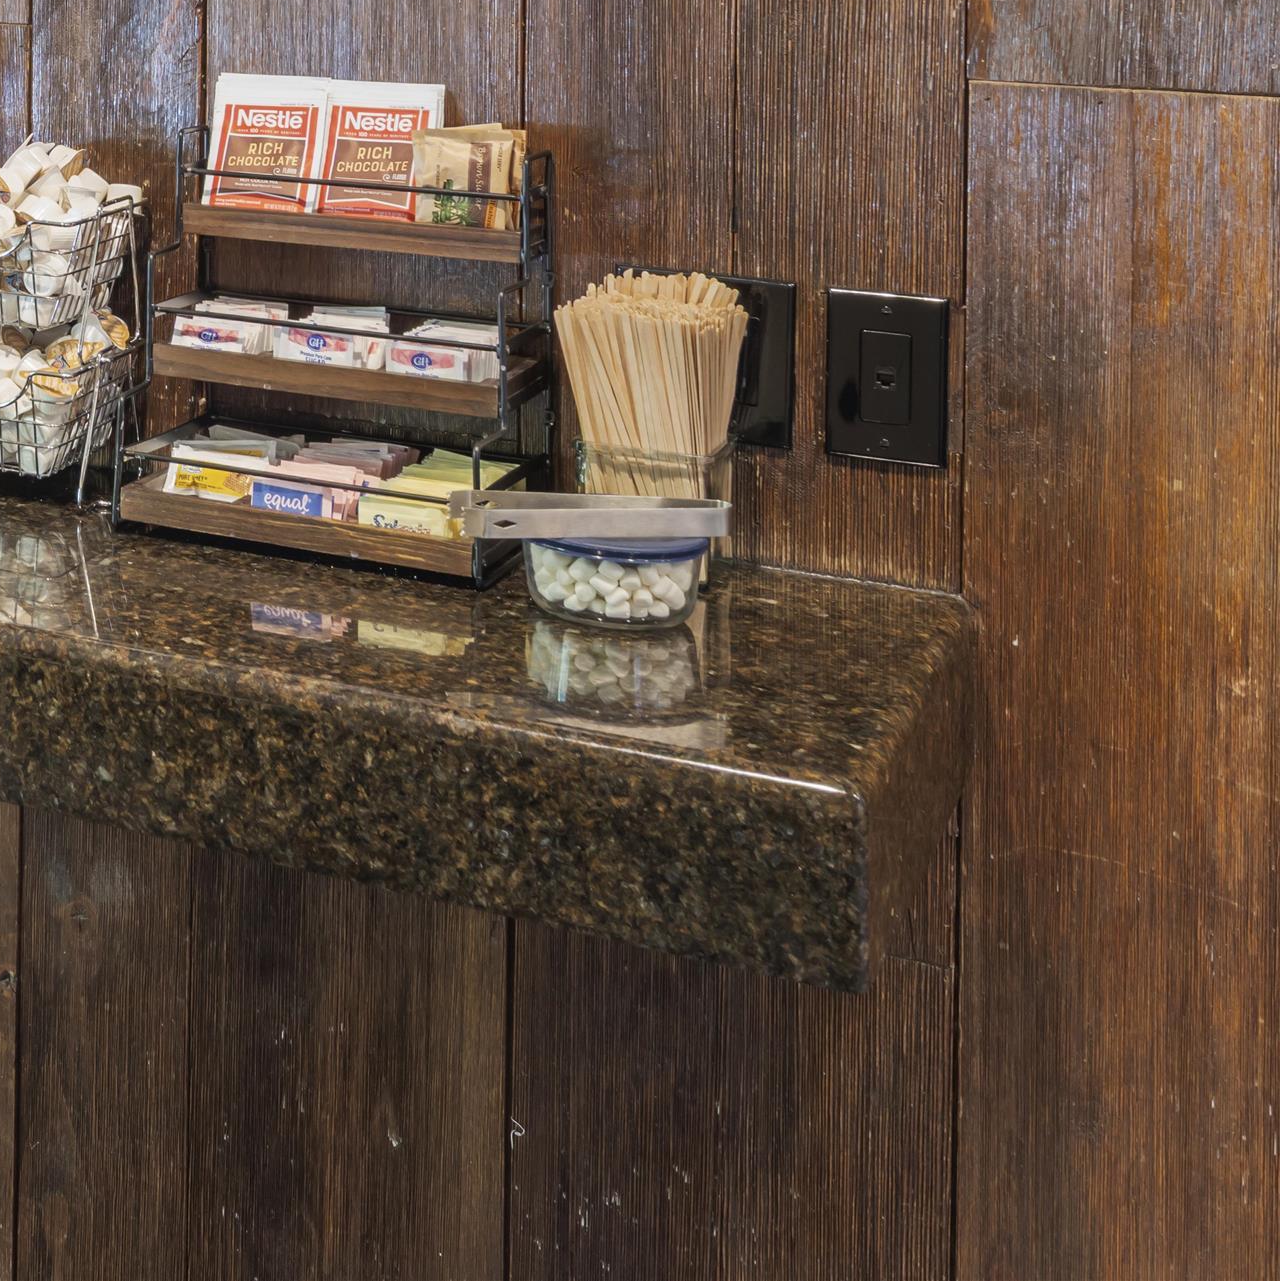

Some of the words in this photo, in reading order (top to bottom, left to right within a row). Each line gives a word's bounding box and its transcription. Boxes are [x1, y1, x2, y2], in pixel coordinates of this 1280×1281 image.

[248, 142, 284, 155] RICH
[357, 146, 392, 160] RICH
[228, 156, 299, 167] CHOCOLATE
[337, 161, 409, 173] CHOCOLATE
[264, 491, 309, 514] equal
